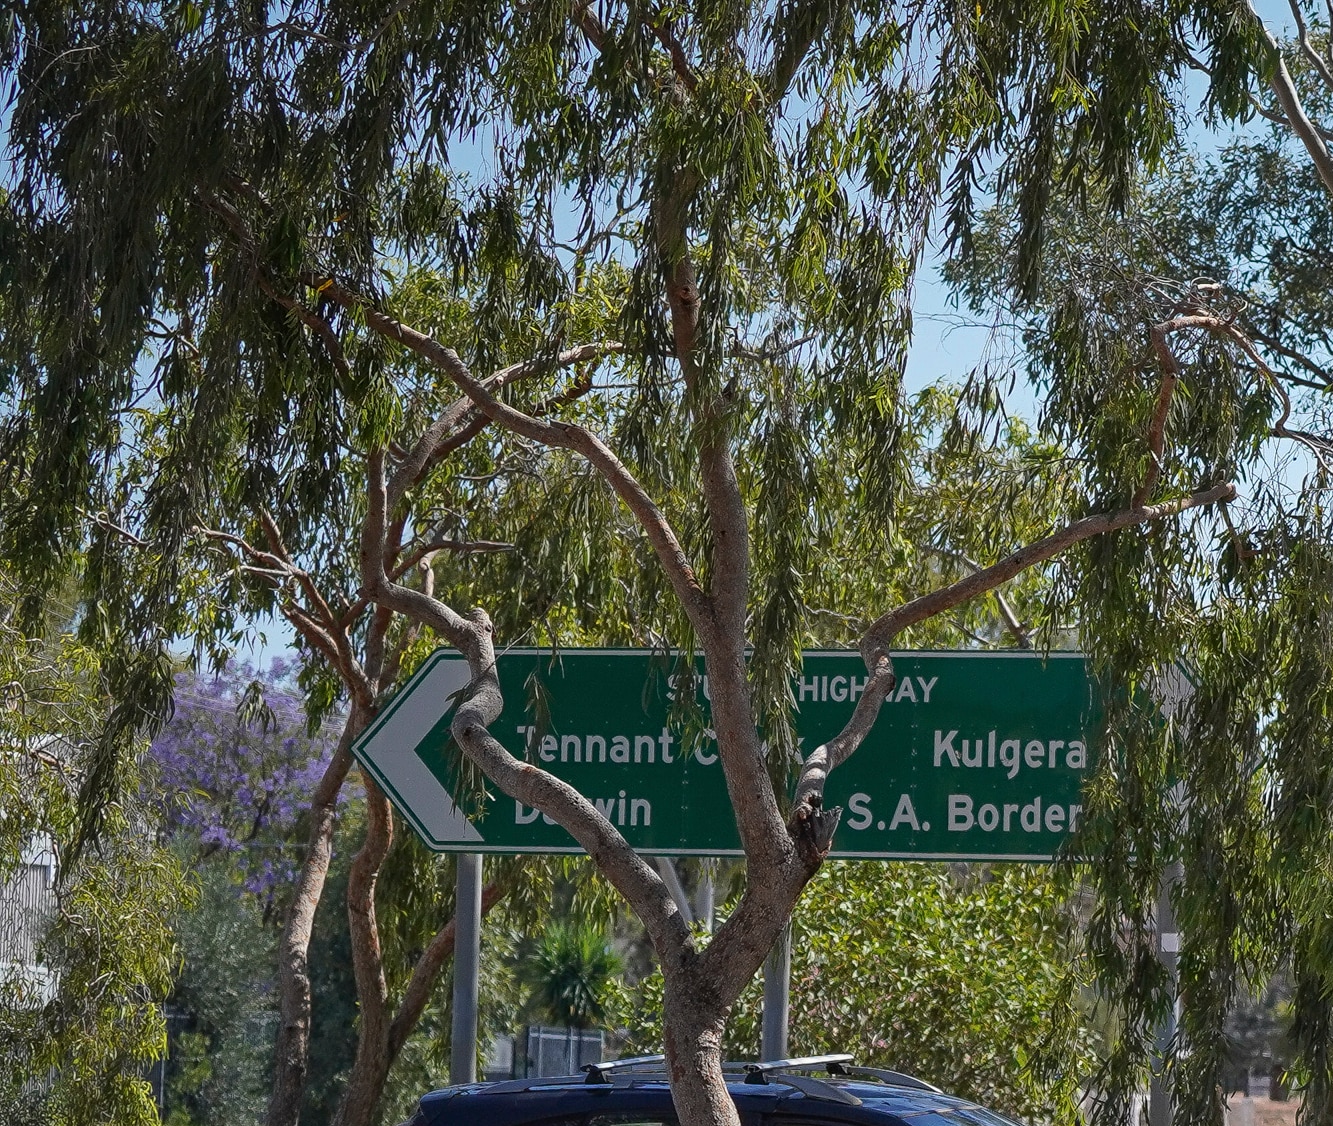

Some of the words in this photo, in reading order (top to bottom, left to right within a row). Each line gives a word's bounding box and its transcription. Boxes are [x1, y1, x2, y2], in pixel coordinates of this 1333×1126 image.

[799, 674, 939, 702] HIGHAY
[516, 725, 674, 763] Tennant
[932, 729, 1087, 780] Kulgera
[514, 788, 651, 826] Dwin
[846, 792, 931, 831] S.A.
[947, 795, 1083, 833] Border
